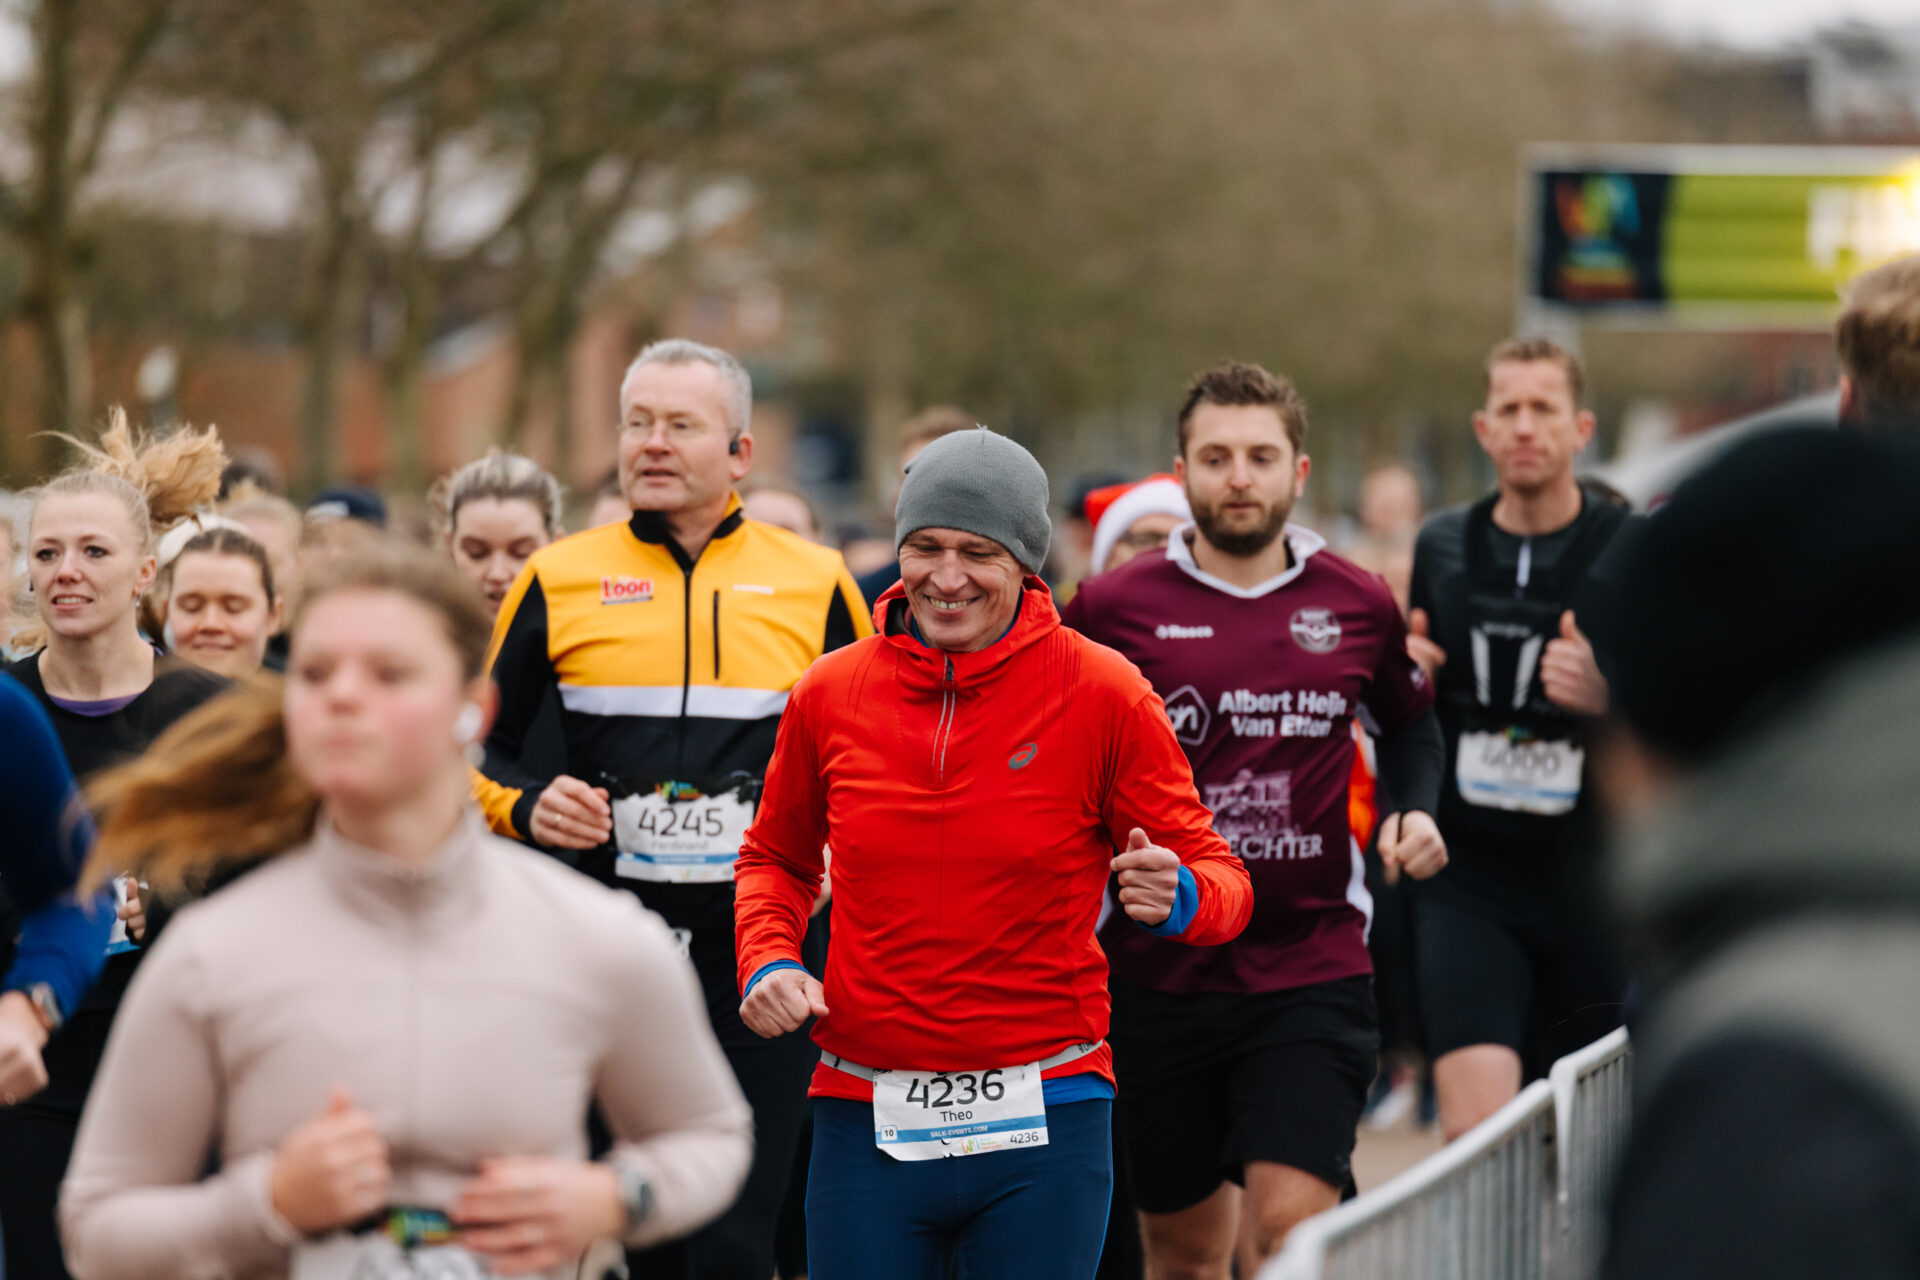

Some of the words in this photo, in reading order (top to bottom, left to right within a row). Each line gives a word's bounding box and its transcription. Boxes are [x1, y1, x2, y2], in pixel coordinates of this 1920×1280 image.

[1218, 688, 1293, 714] Albert
[1231, 714, 1275, 737] Van
[637, 807, 724, 837] 4245
[906, 1068, 1006, 1110] 4236
[939, 1109, 974, 1123] Theo
[884, 1128, 895, 1137] 10
[1009, 1131, 1040, 1145] 4236
